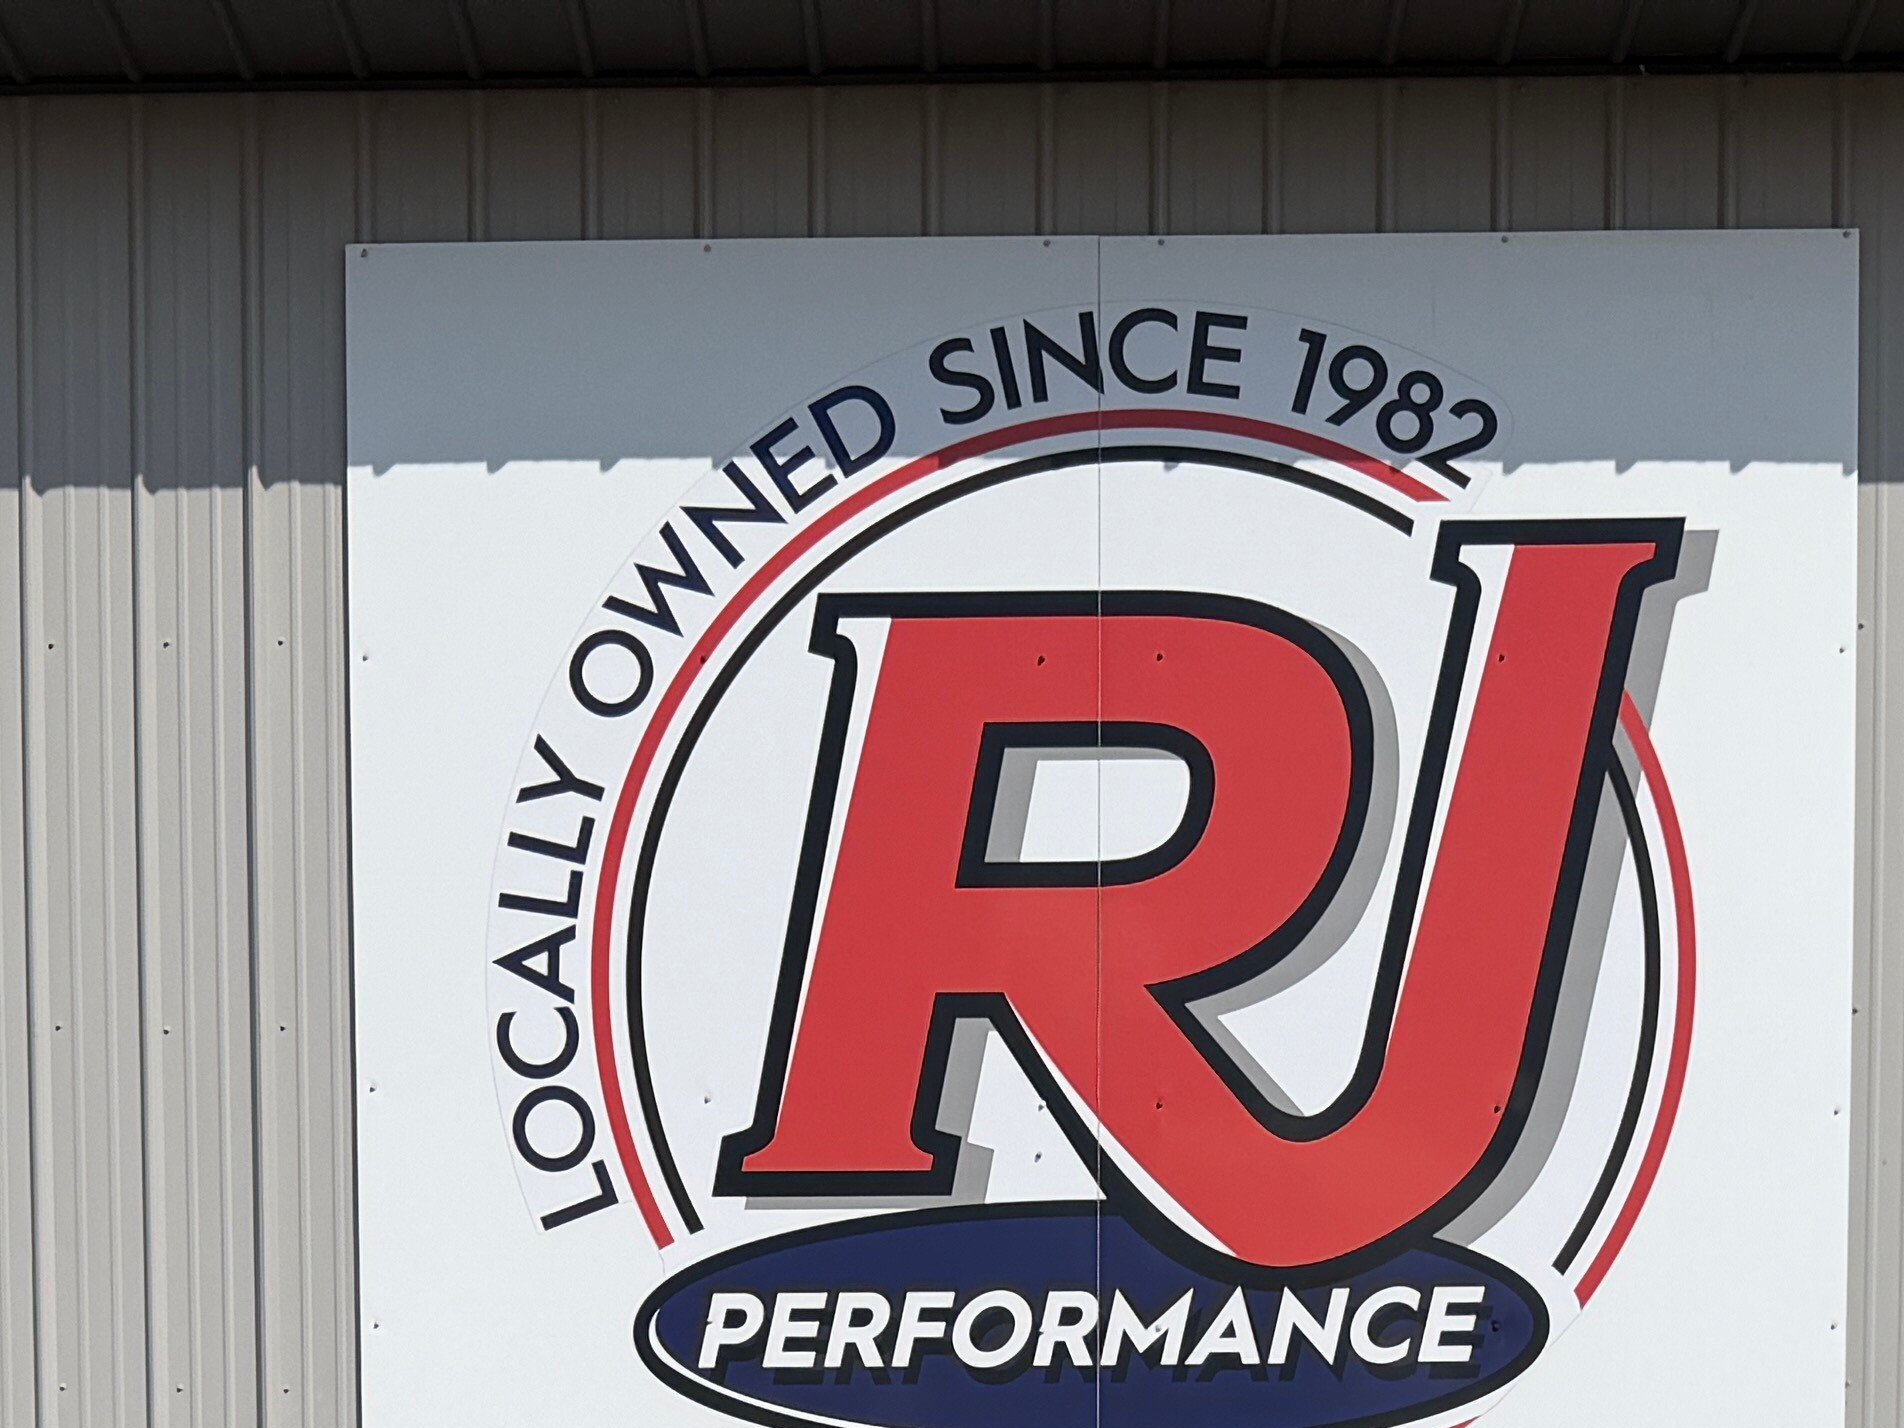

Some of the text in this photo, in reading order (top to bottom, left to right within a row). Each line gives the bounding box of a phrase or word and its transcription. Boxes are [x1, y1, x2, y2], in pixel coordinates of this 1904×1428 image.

[496, 305, 1499, 1231] LOCALLY OWNED SINCE 1982
[712, 516, 1688, 1286] RJ
[698, 1284, 1484, 1370] PERFORMANCE
